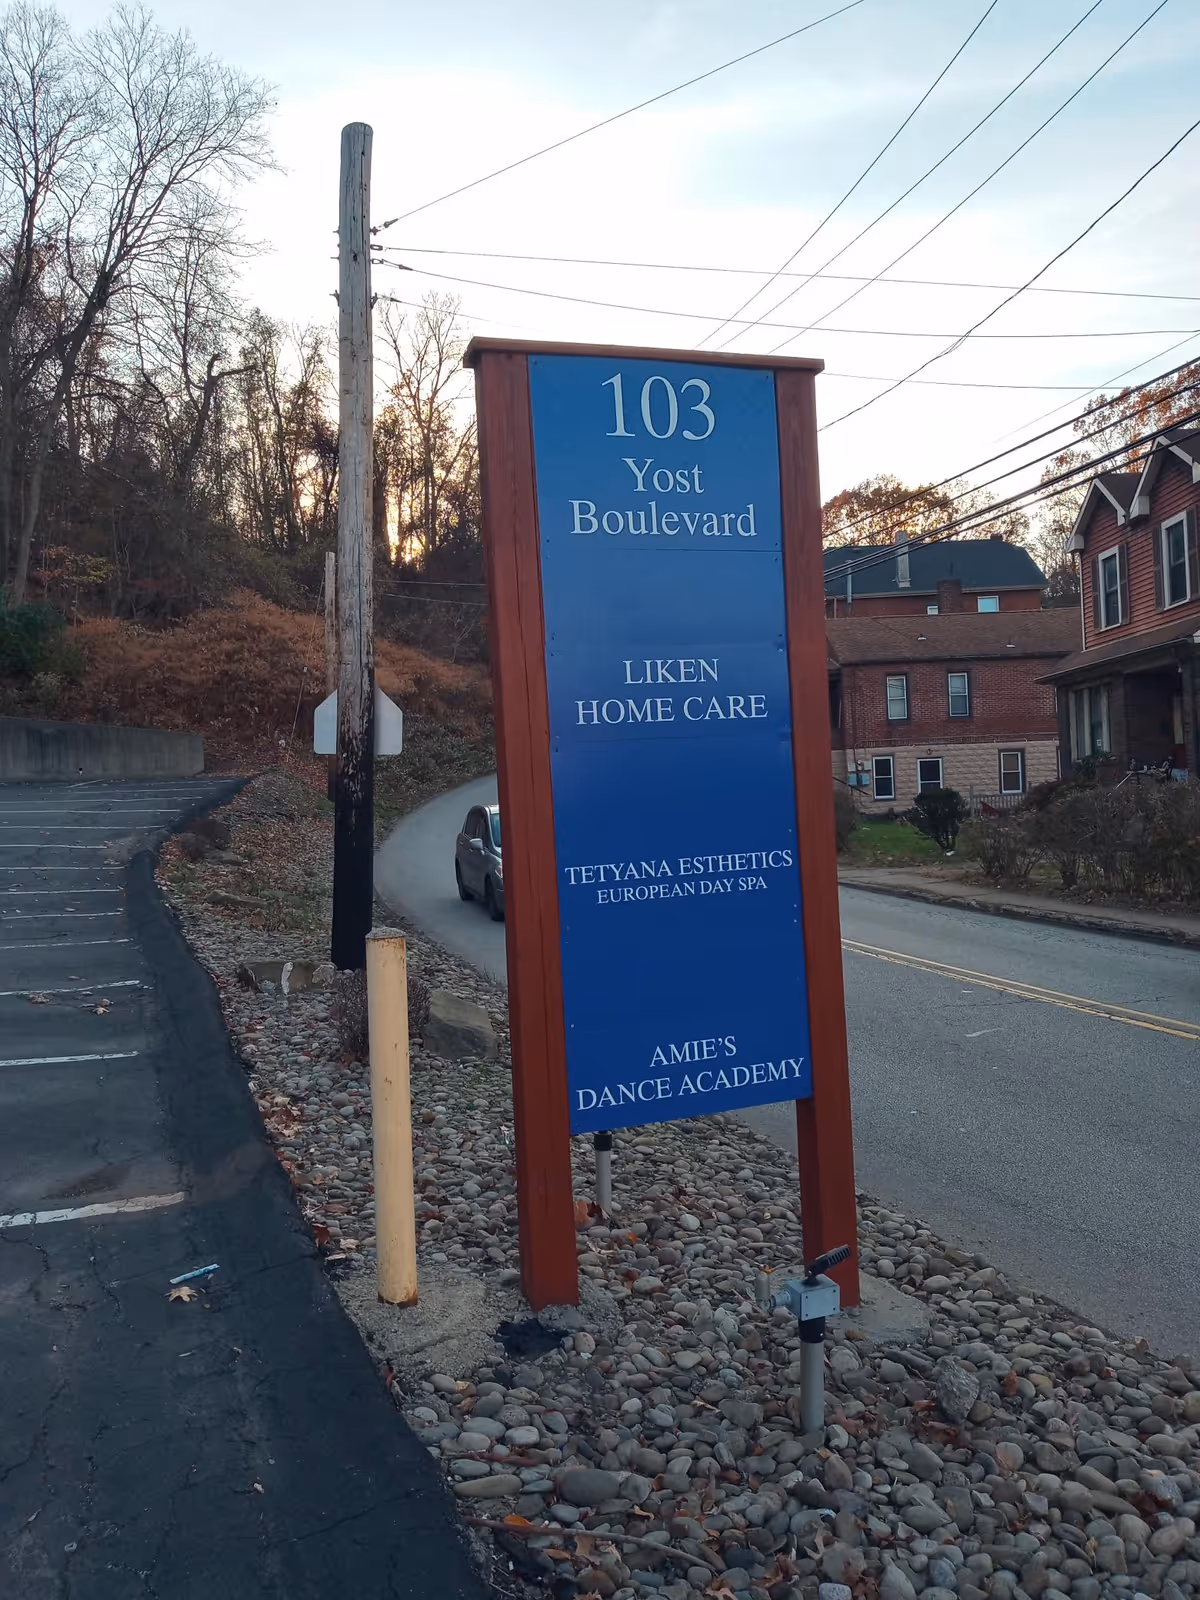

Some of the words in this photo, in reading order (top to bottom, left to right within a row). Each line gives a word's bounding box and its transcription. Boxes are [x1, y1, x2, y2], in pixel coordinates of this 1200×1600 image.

[601, 372, 716, 441] 103
[621, 457, 705, 494] Yost
[568, 499, 758, 537] Boulevard
[622, 658, 720, 685] LIKEN
[574, 698, 676, 725] HOME
[683, 694, 769, 721] CARE
[564, 859, 674, 886] TETYANA
[678, 849, 794, 876] ESTHETICS
[596, 881, 696, 905] EUROPEAN
[699, 878, 735, 896] DAY
[738, 875, 768, 892] SPA
[649, 1035, 738, 1068] AMIE'S
[575, 1077, 673, 1111] DANCE
[677, 1057, 805, 1097] ACADEMY
